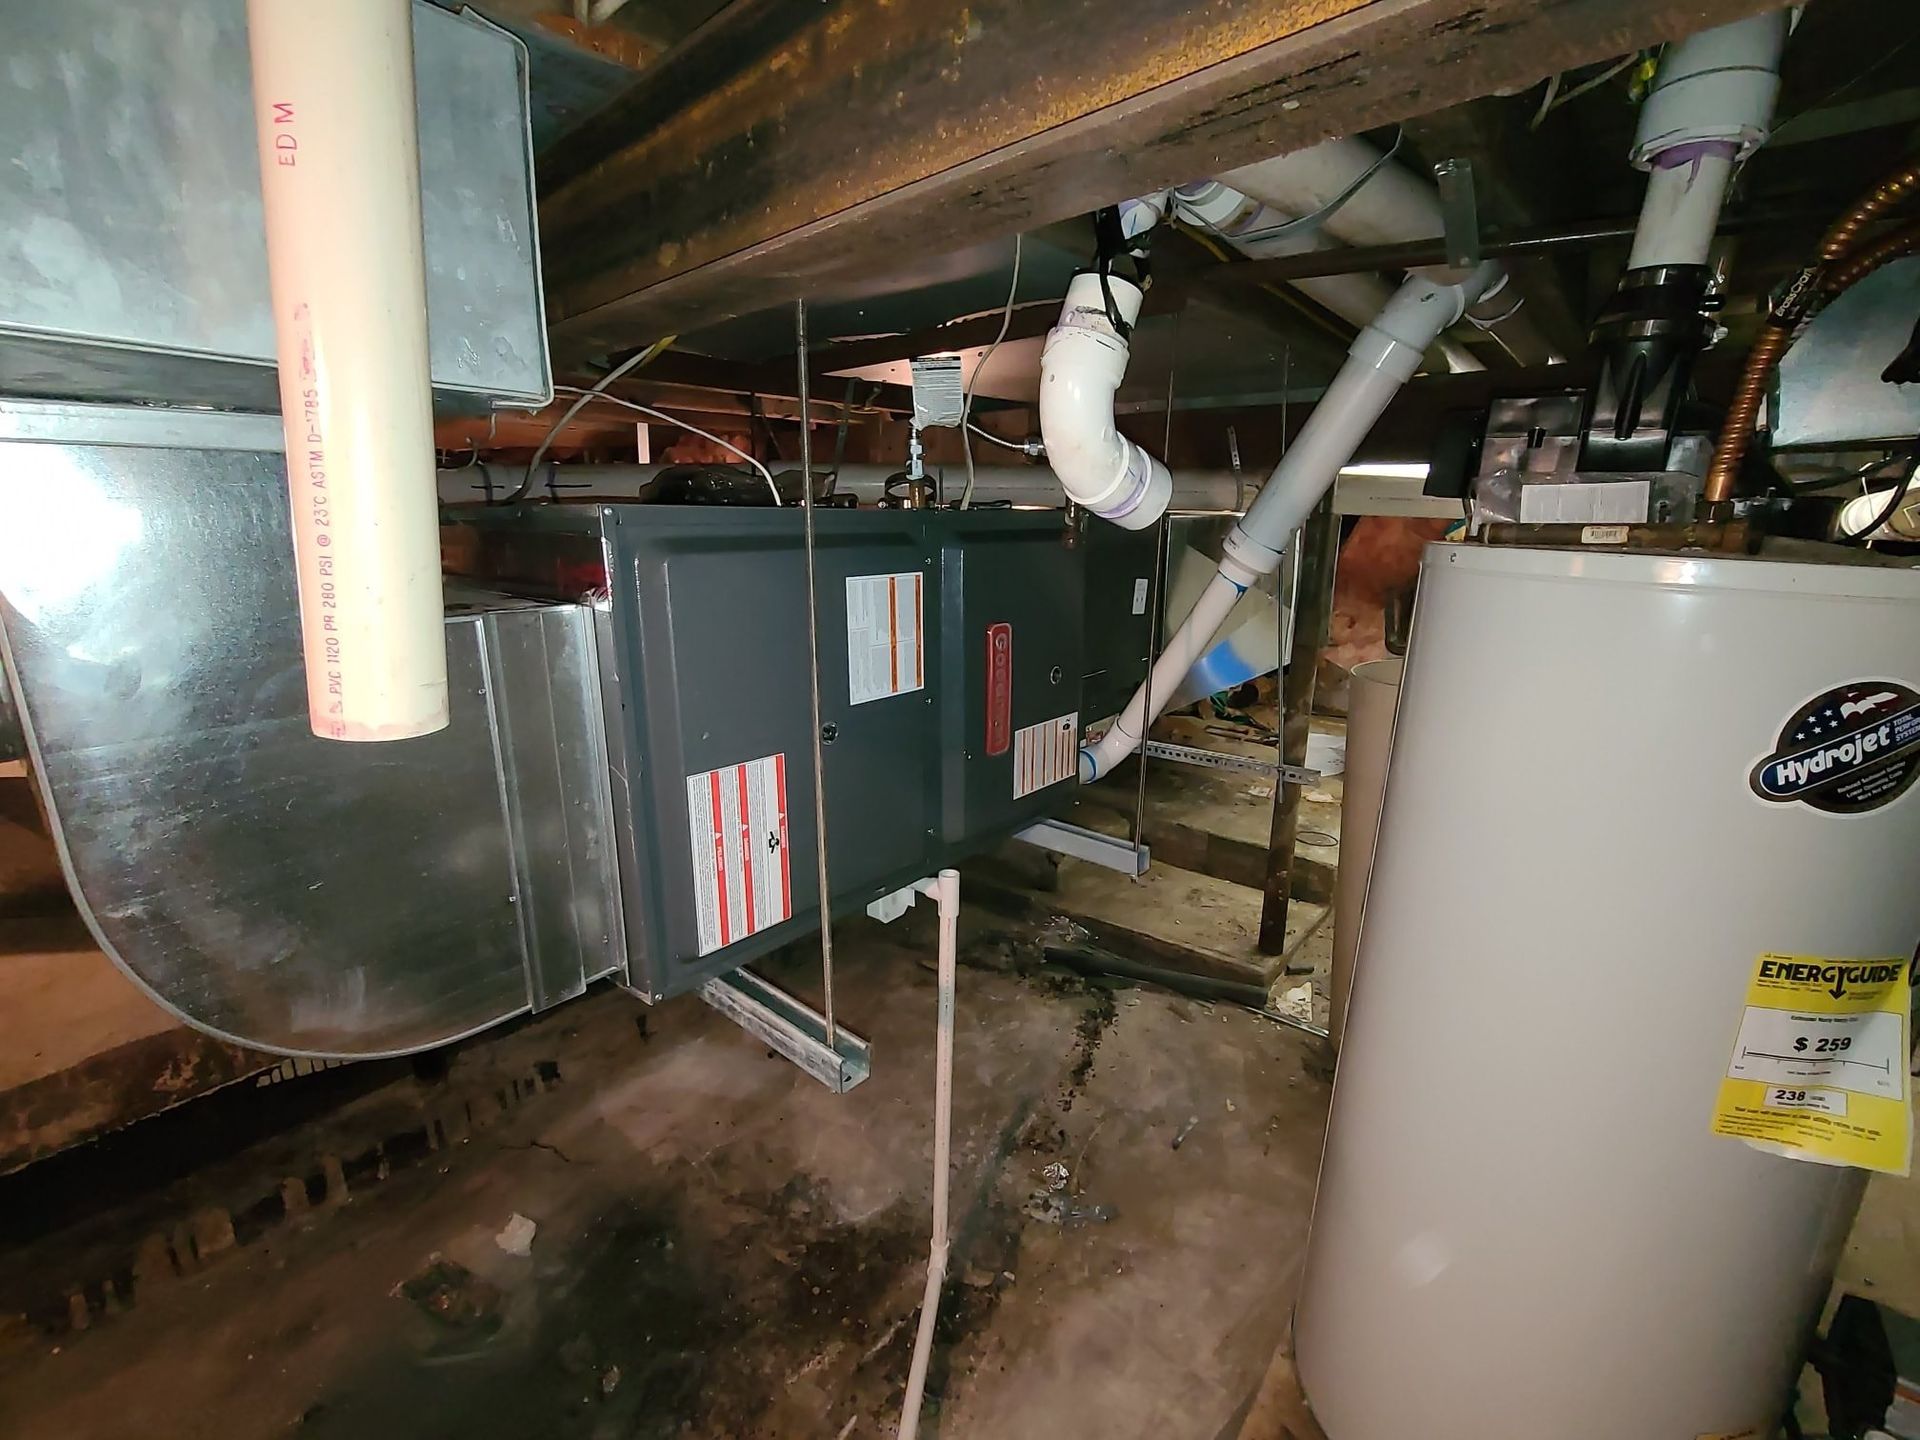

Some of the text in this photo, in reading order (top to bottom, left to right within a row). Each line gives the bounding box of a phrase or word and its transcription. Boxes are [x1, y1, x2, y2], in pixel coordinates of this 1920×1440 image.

[309, 450, 326, 489] ASTM
[317, 534, 331, 547] @
[318, 555, 333, 576] PSI
[321, 582, 337, 608] 280
[323, 615, 338, 631] PR
[325, 638, 340, 663] 1120
[328, 671, 342, 695] PVC
[1775, 724, 1891, 786] Hydrojet
[1759, 960, 1903, 985] ENERGYGUIDE
[1793, 1036, 1852, 1053] $ 259
[1775, 1089, 1806, 1101] 238
